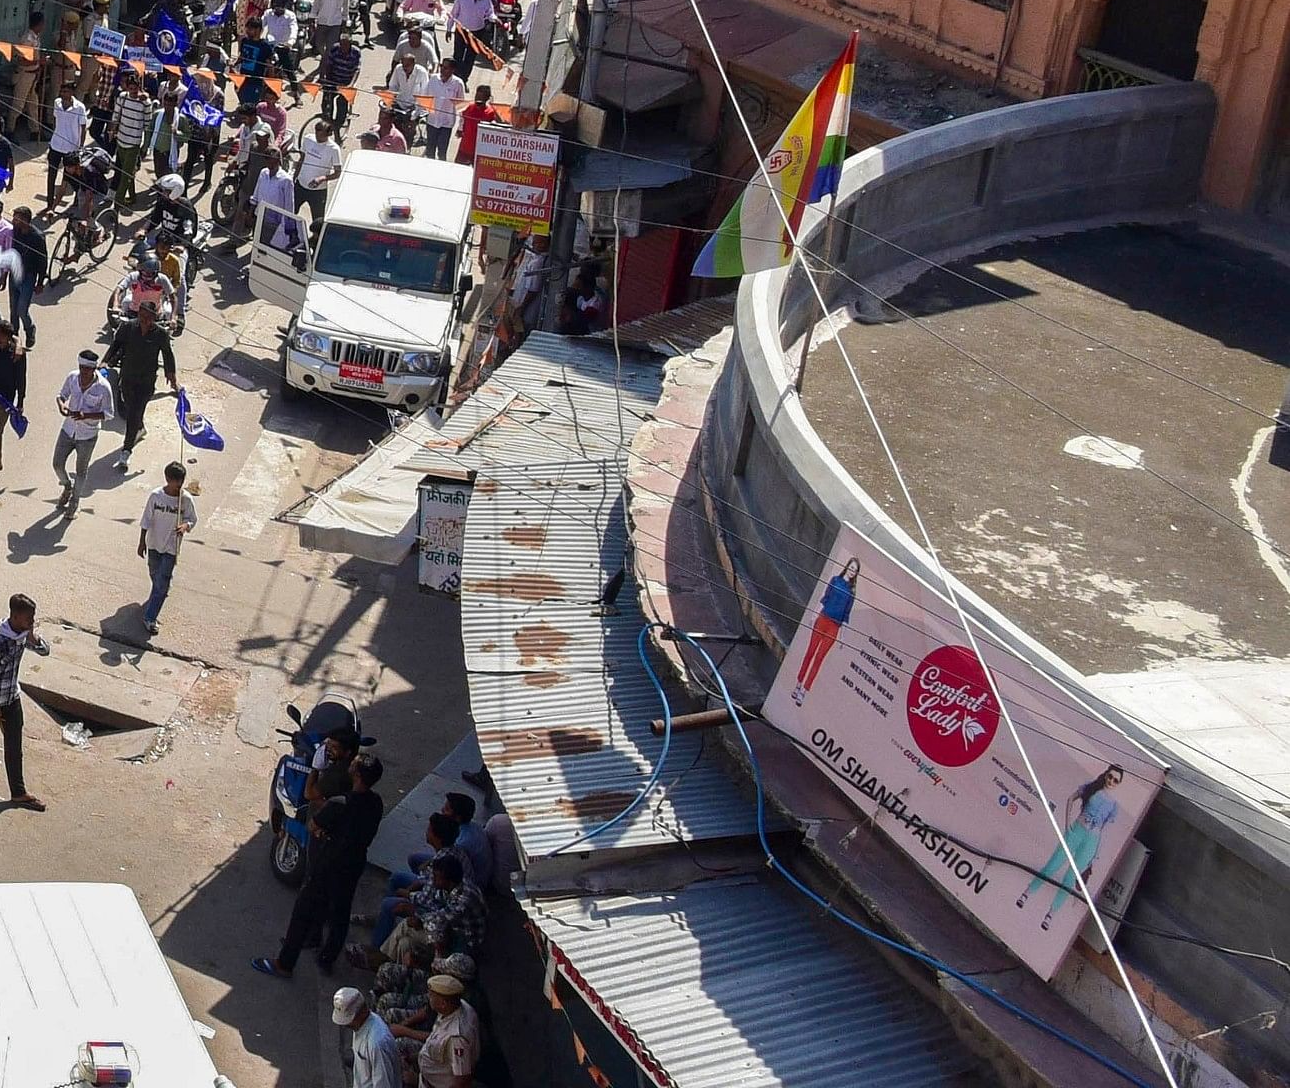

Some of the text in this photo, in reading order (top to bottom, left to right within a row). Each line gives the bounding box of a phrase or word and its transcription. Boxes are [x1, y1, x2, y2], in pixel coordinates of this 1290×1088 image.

[481, 132, 555, 154] MARG DARSHAN
[500, 148, 533, 162] HOMES
[859, 649, 900, 685] ETHNIC WEAR
[869, 636, 904, 668] DAILY WEAR
[841, 675, 889, 718] AND MANY MORE
[849, 661, 895, 703] WESTERN WEAR
[920, 666, 988, 712] Comfort
[909, 693, 963, 736] Lady
[903, 748, 943, 786] everyday
[992, 775, 1011, 794] Follow
[811, 728, 990, 895] OM SHANTI FASHION
